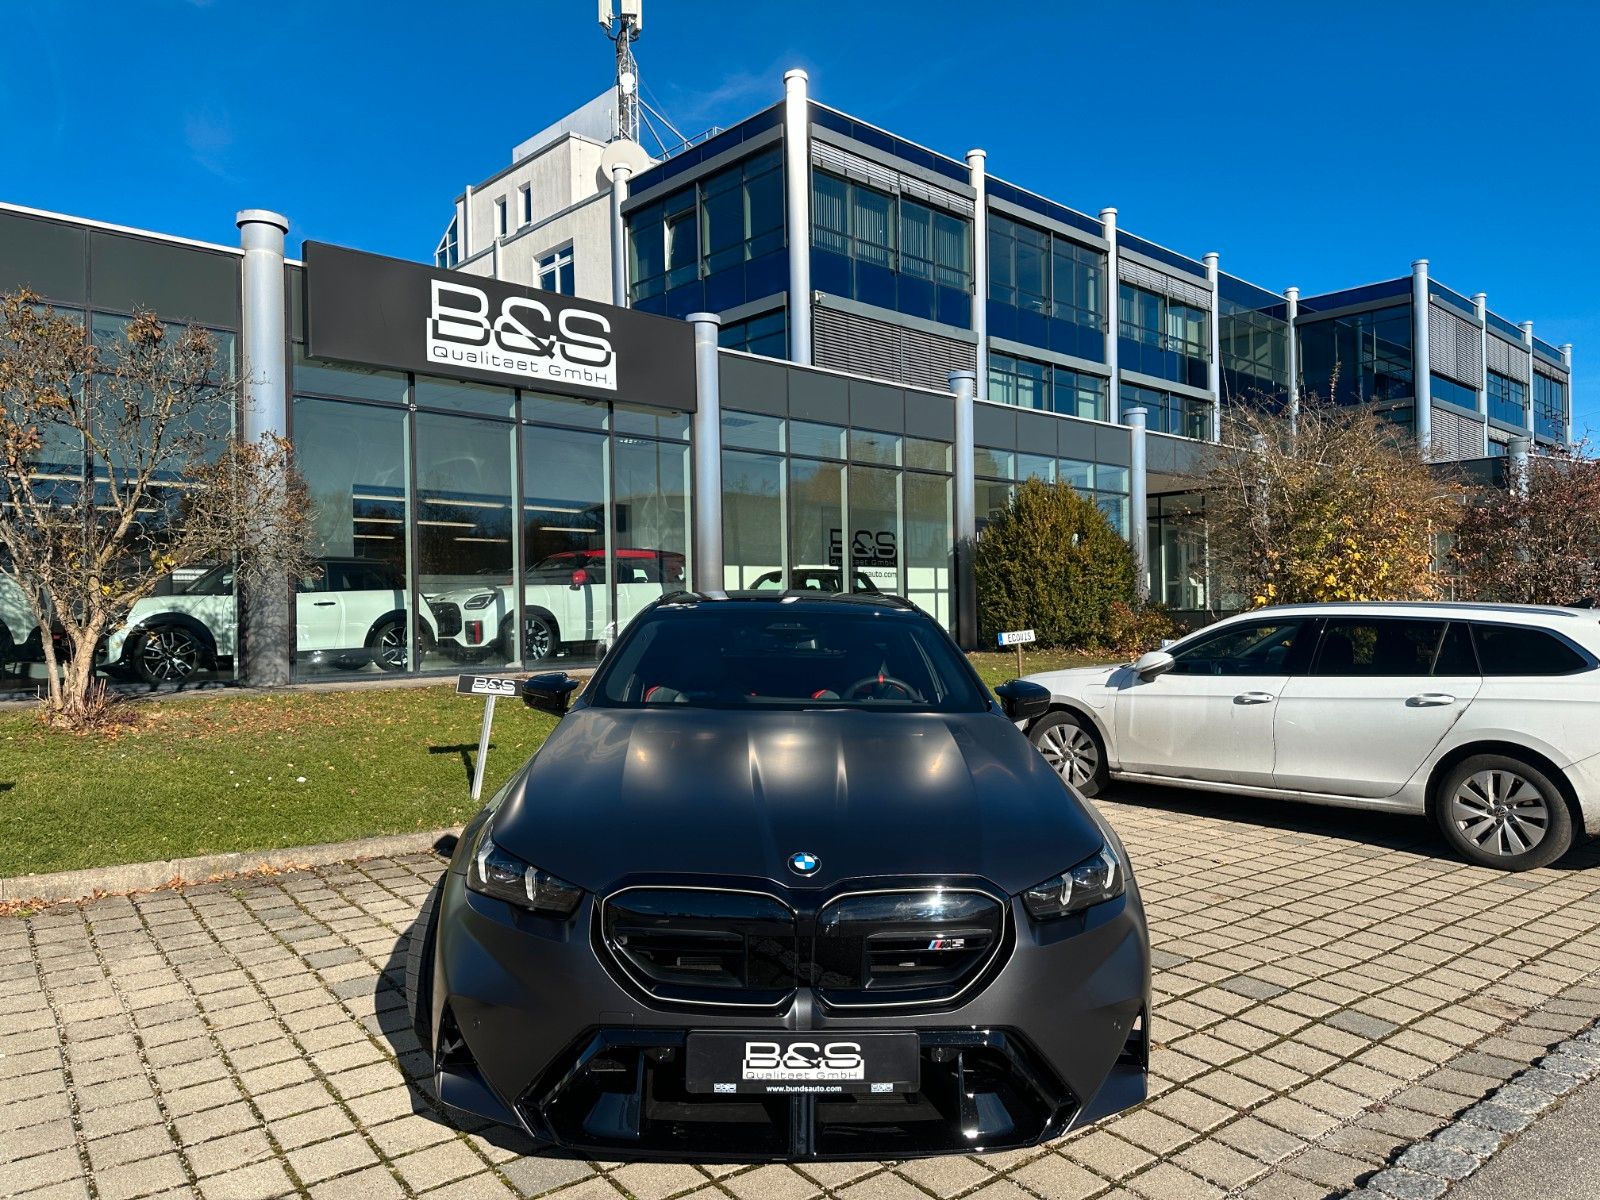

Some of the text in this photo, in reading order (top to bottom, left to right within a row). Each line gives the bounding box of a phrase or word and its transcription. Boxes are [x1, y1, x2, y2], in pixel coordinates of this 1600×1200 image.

[431, 279, 612, 367] B&S
[433, 345, 539, 373] Qualitaet
[474, 677, 515, 691] B&S
[745, 1042, 861, 1069] B&S
[745, 1071, 810, 1079] Qualitaet
[766, 1084, 842, 1093] www.bundsauto.com
